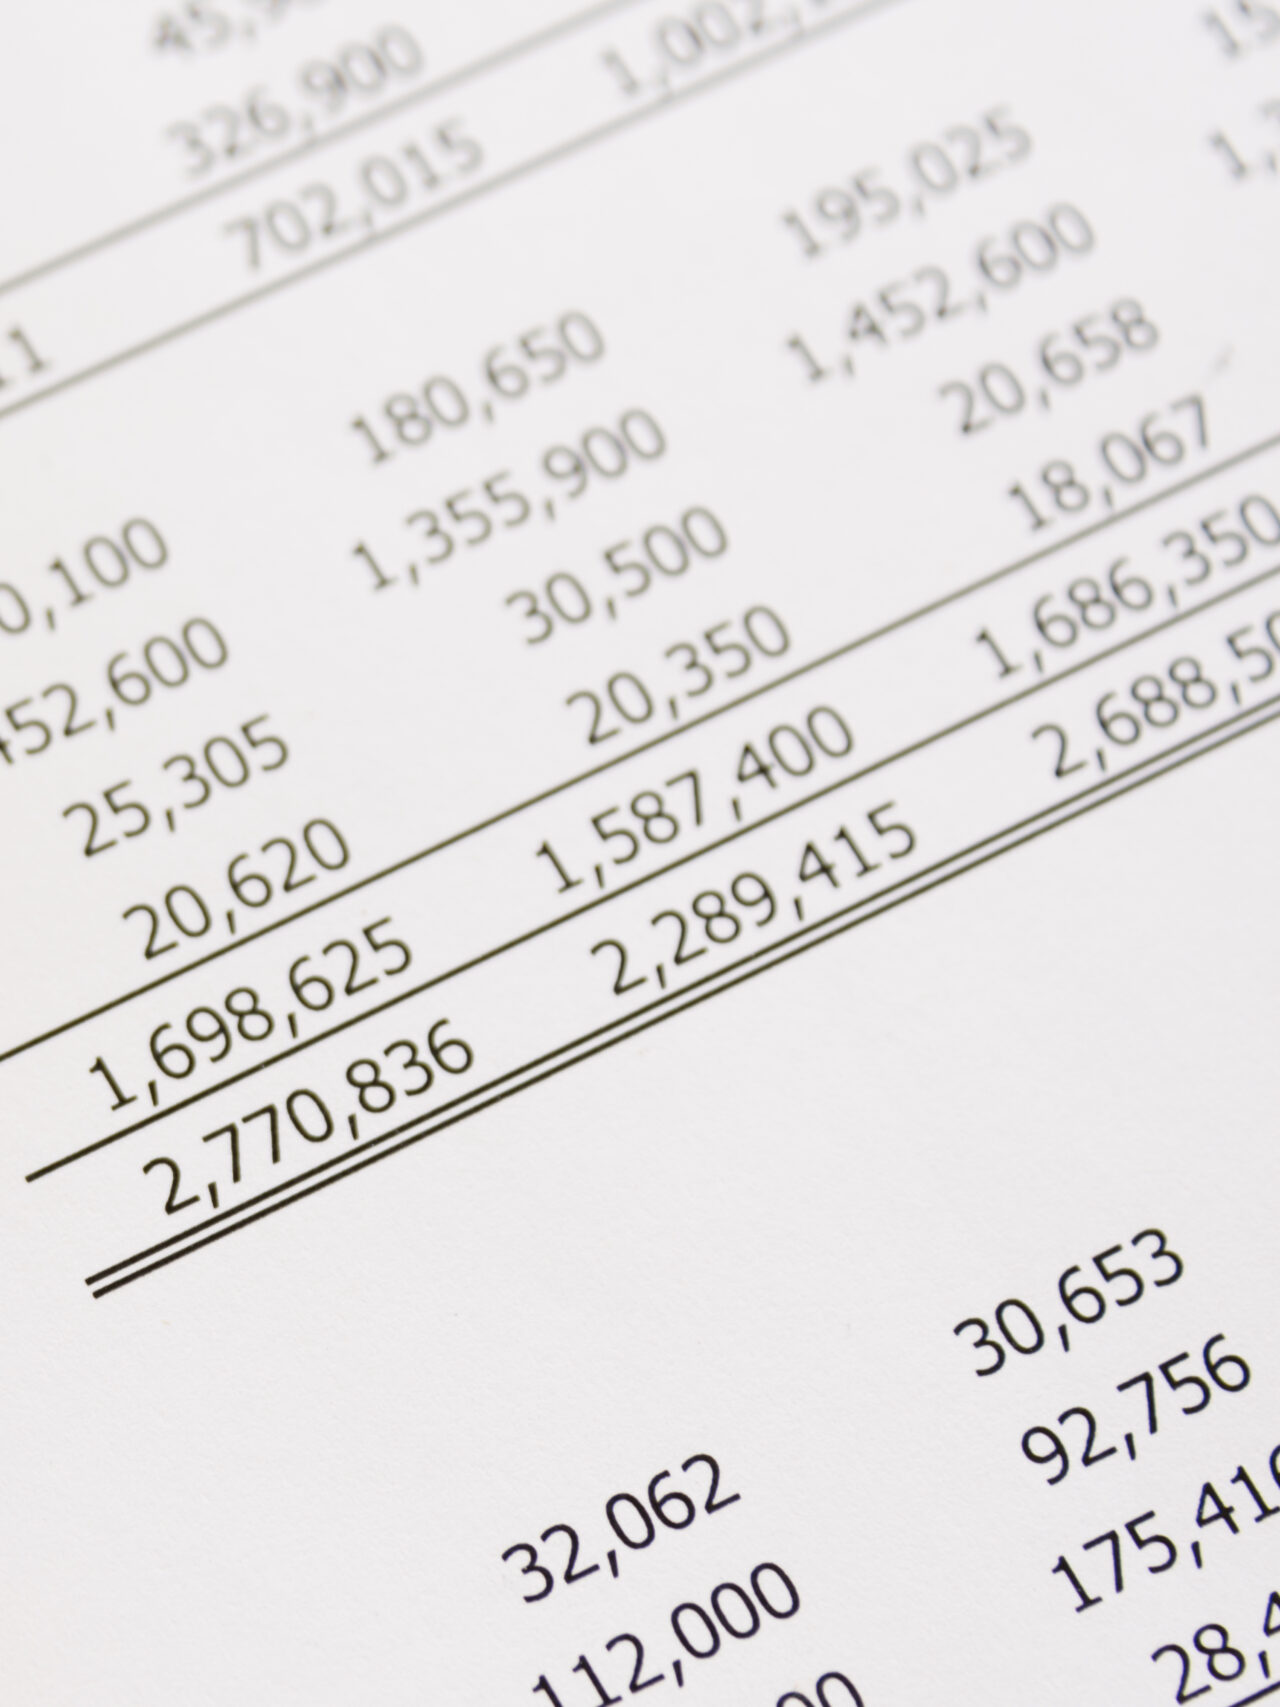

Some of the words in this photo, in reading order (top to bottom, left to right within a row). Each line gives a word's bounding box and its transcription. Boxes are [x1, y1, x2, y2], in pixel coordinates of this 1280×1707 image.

[163, 23, 426, 182] 326,900
[223, 119, 485, 274] 702,015
[782, 106, 1033, 258] 195,025
[787, 202, 1096, 384] 1,452,600
[938, 296, 1160, 436] 20,658
[349, 310, 606, 466] 180,650
[1008, 393, 1212, 532] 18,067
[352, 408, 668, 592] 1,355,900
[503, 505, 730, 645] 30,500
[974, 494, 1280, 680] 1,686,350
[565, 605, 791, 745] 20,350
[62, 714, 289, 858] 25,305
[535, 705, 855, 894] 1,587,400
[122, 818, 350, 960] 20,620
[590, 801, 916, 995] 2,289,415
[89, 916, 412, 1111] 1,698,625
[142, 1018, 475, 1216] 2,770,836
[953, 1228, 1185, 1377] 30,653
[1021, 1334, 1252, 1486] 92,756
[501, 1453, 741, 1603] 32,062
[1051, 1443, 1280, 1613] 175,41
[532, 1562, 801, 1707] 112,000
